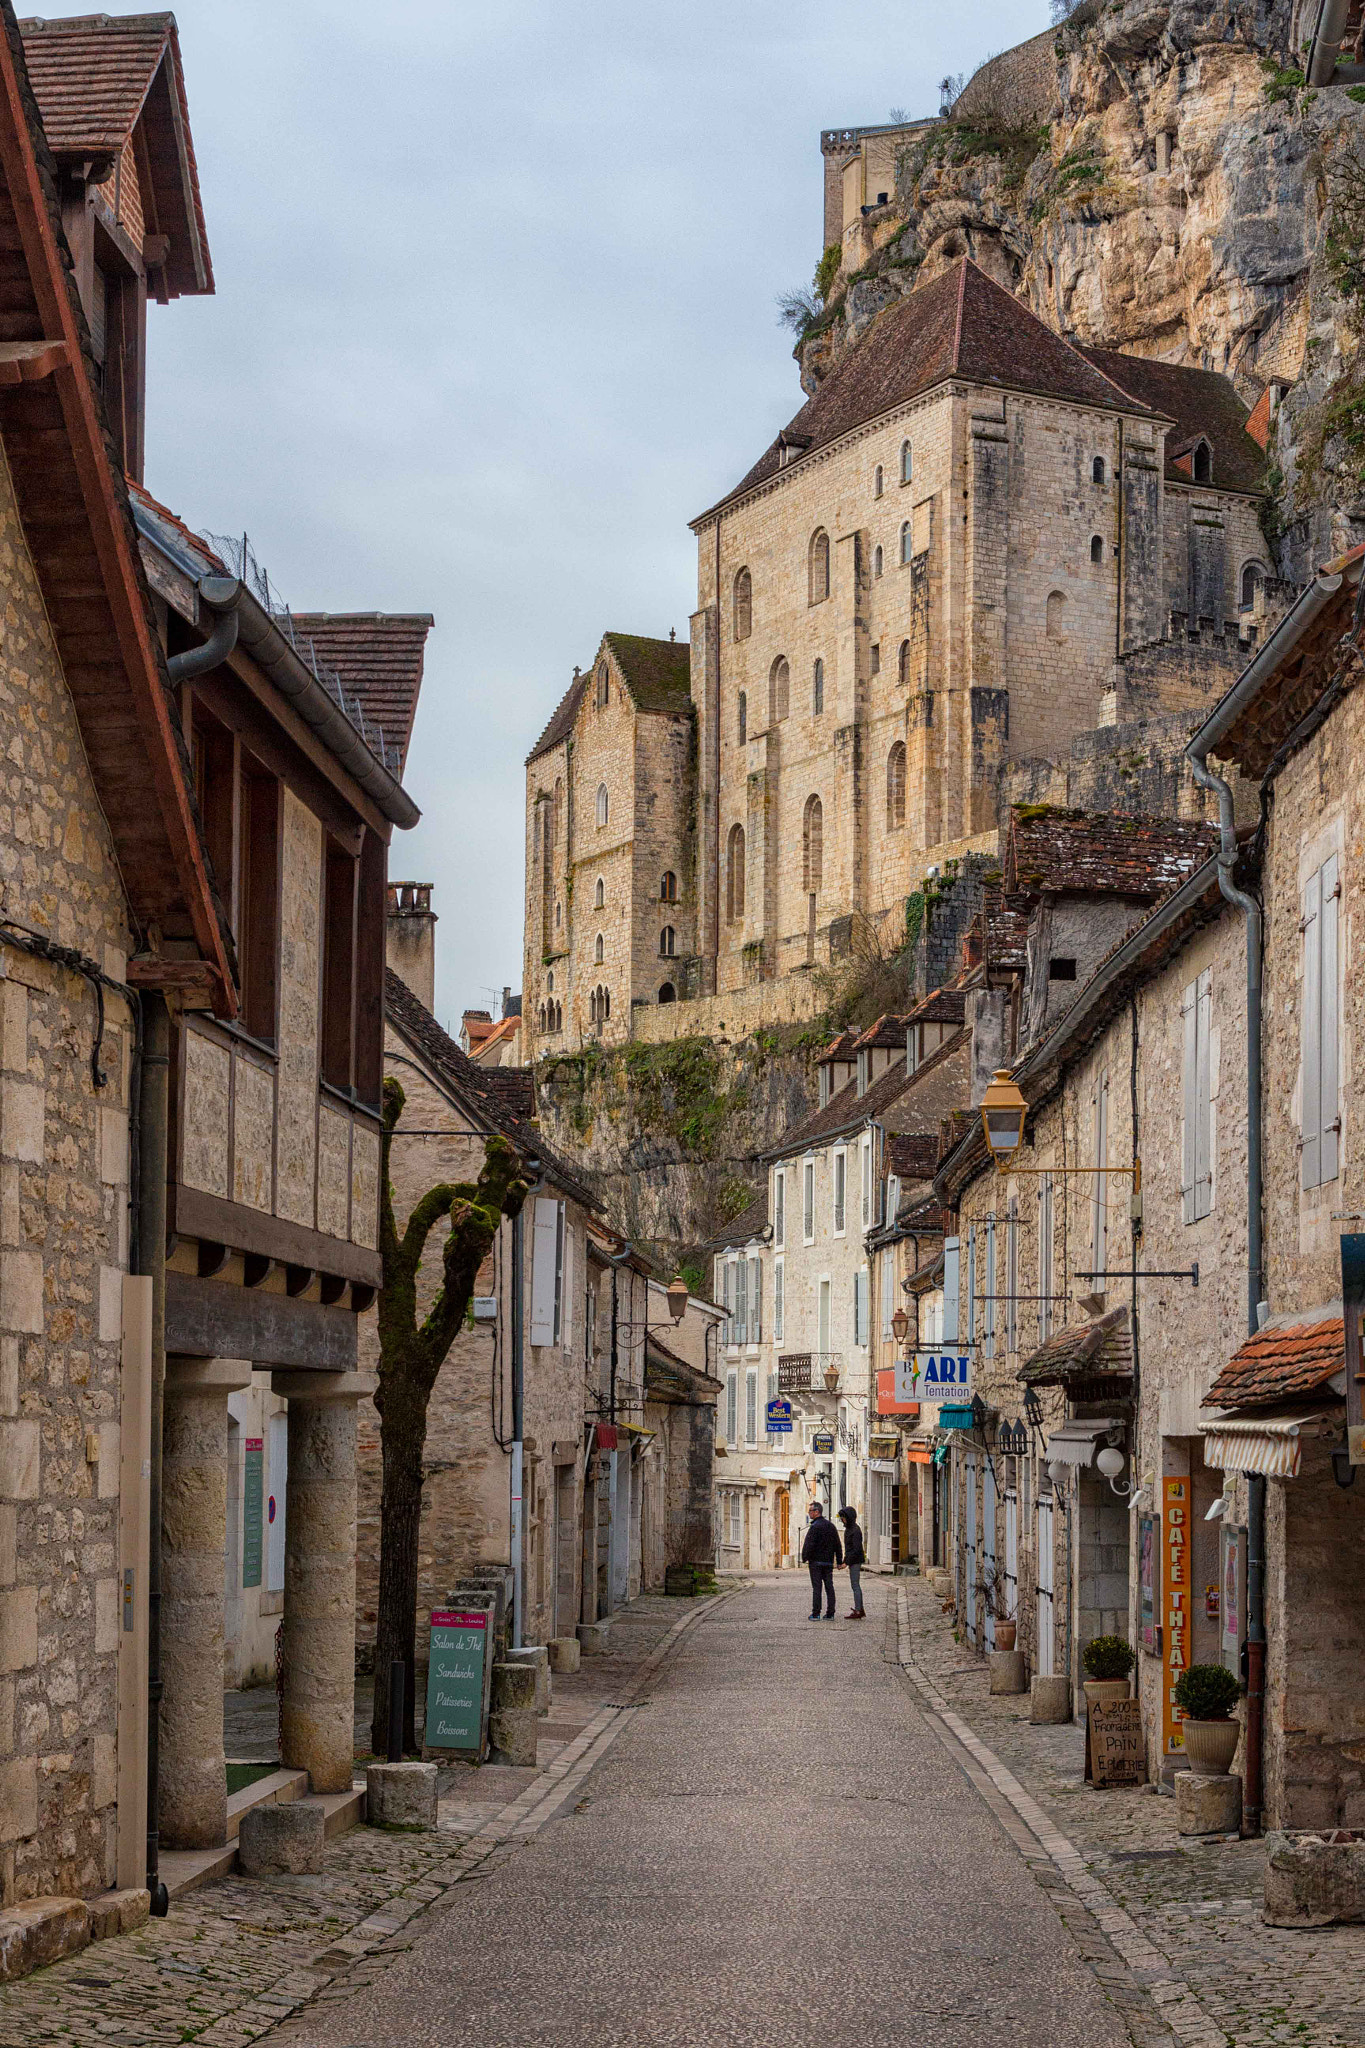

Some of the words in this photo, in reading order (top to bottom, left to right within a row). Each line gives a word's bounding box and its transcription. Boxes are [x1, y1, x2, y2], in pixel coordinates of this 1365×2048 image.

[903, 1361, 912, 1373] B
[924, 1356, 970, 1383] ART
[924, 1384, 970, 1397] Tentation
[1168, 1508, 1186, 1582] CAFÉ
[432, 1634, 454, 1649] Salon
[455, 1635, 465, 1649] de
[465, 1636, 482, 1651] Thé
[435, 1663, 475, 1680] Sandwichs
[435, 1691, 473, 1708] Pâtisseries
[1109, 1702, 1131, 1714] 200
[436, 1720, 468, 1736] Boissons
